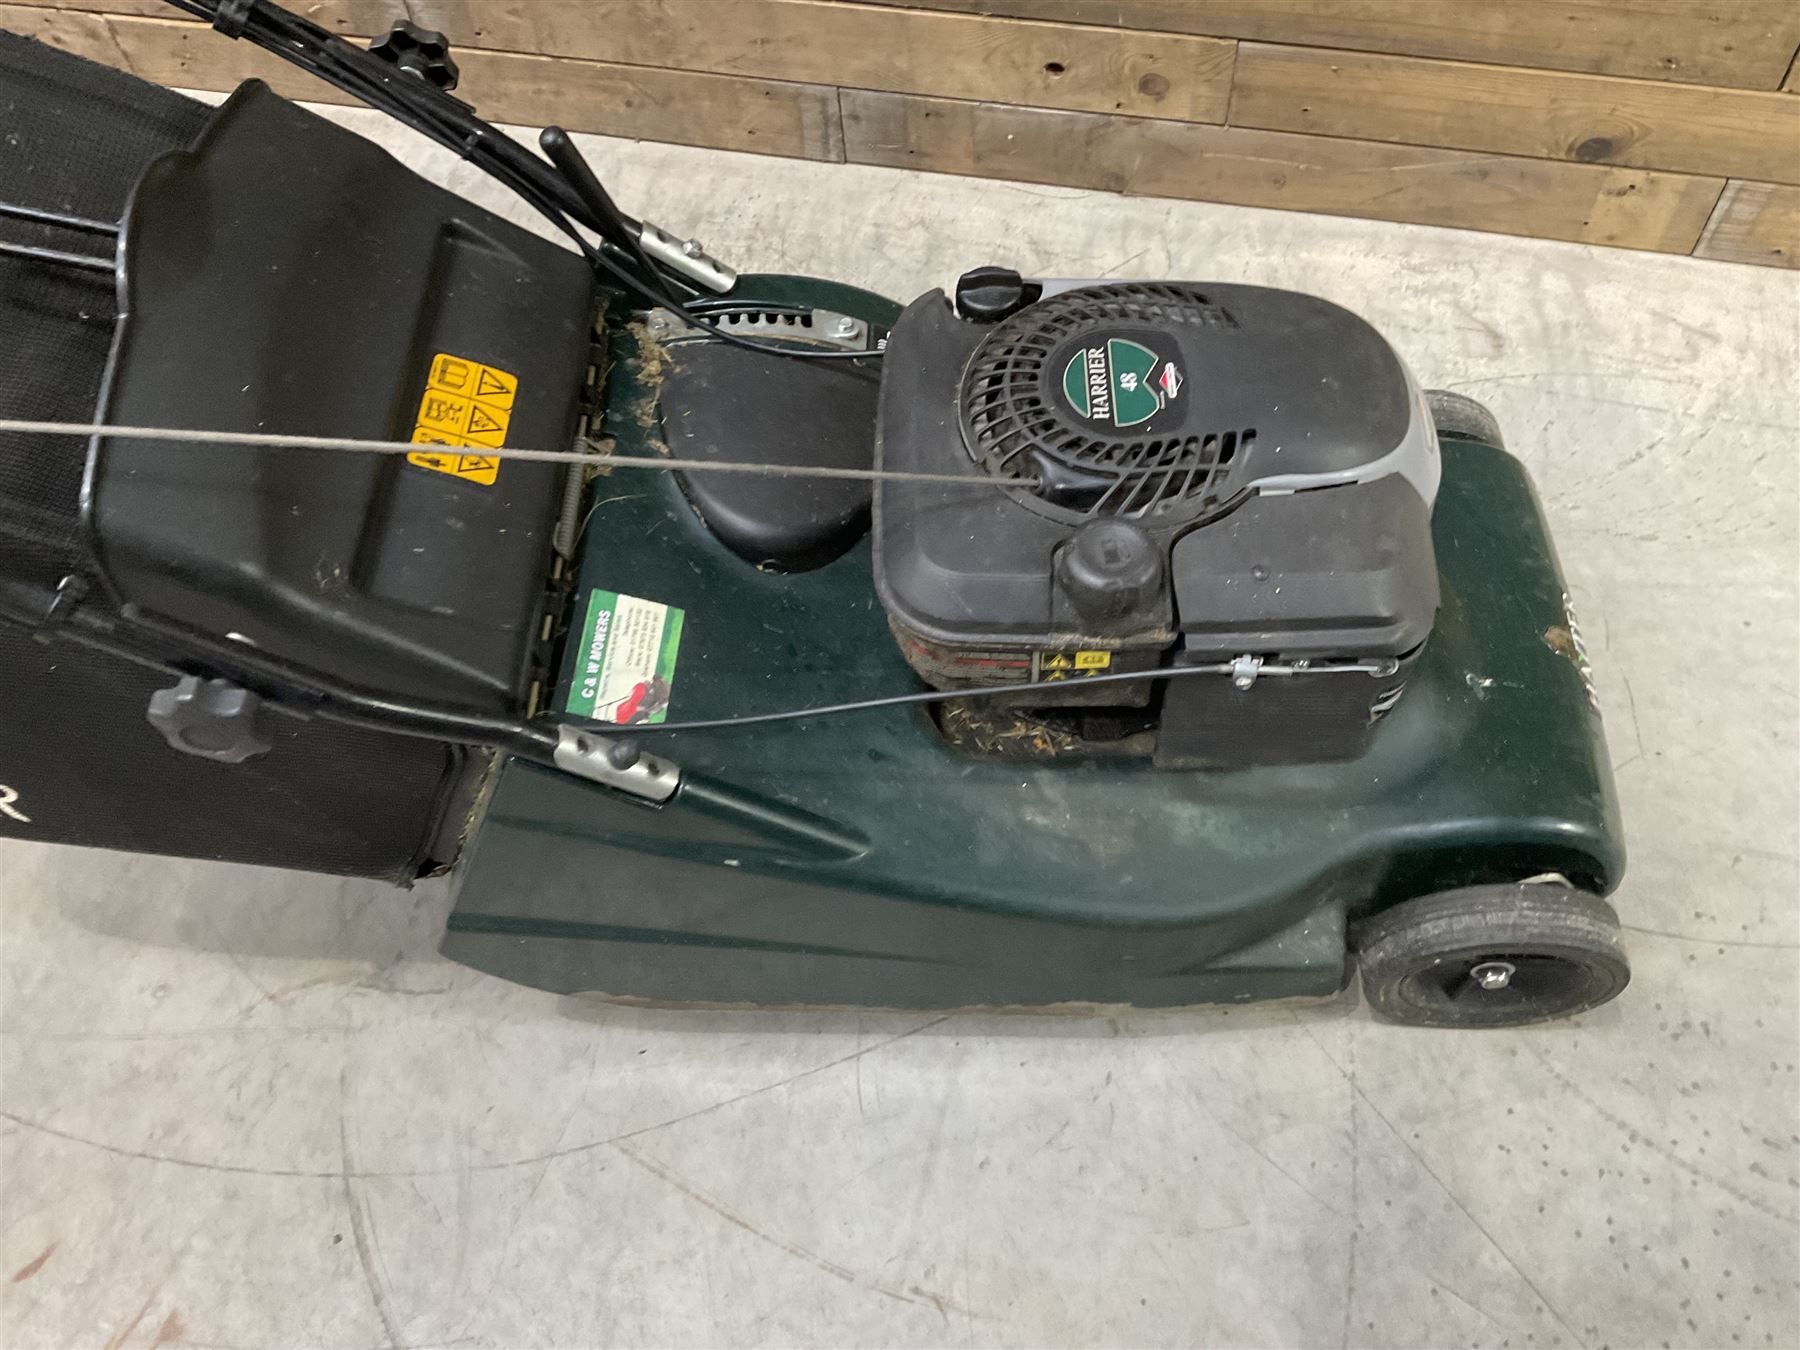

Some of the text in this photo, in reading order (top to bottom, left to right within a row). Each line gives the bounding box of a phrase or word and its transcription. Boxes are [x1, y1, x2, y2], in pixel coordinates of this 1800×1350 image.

[1088, 347, 1109, 419] HARRIER
[1120, 372, 1138, 392] 48
[581, 609, 611, 698] C & W MOWERS
